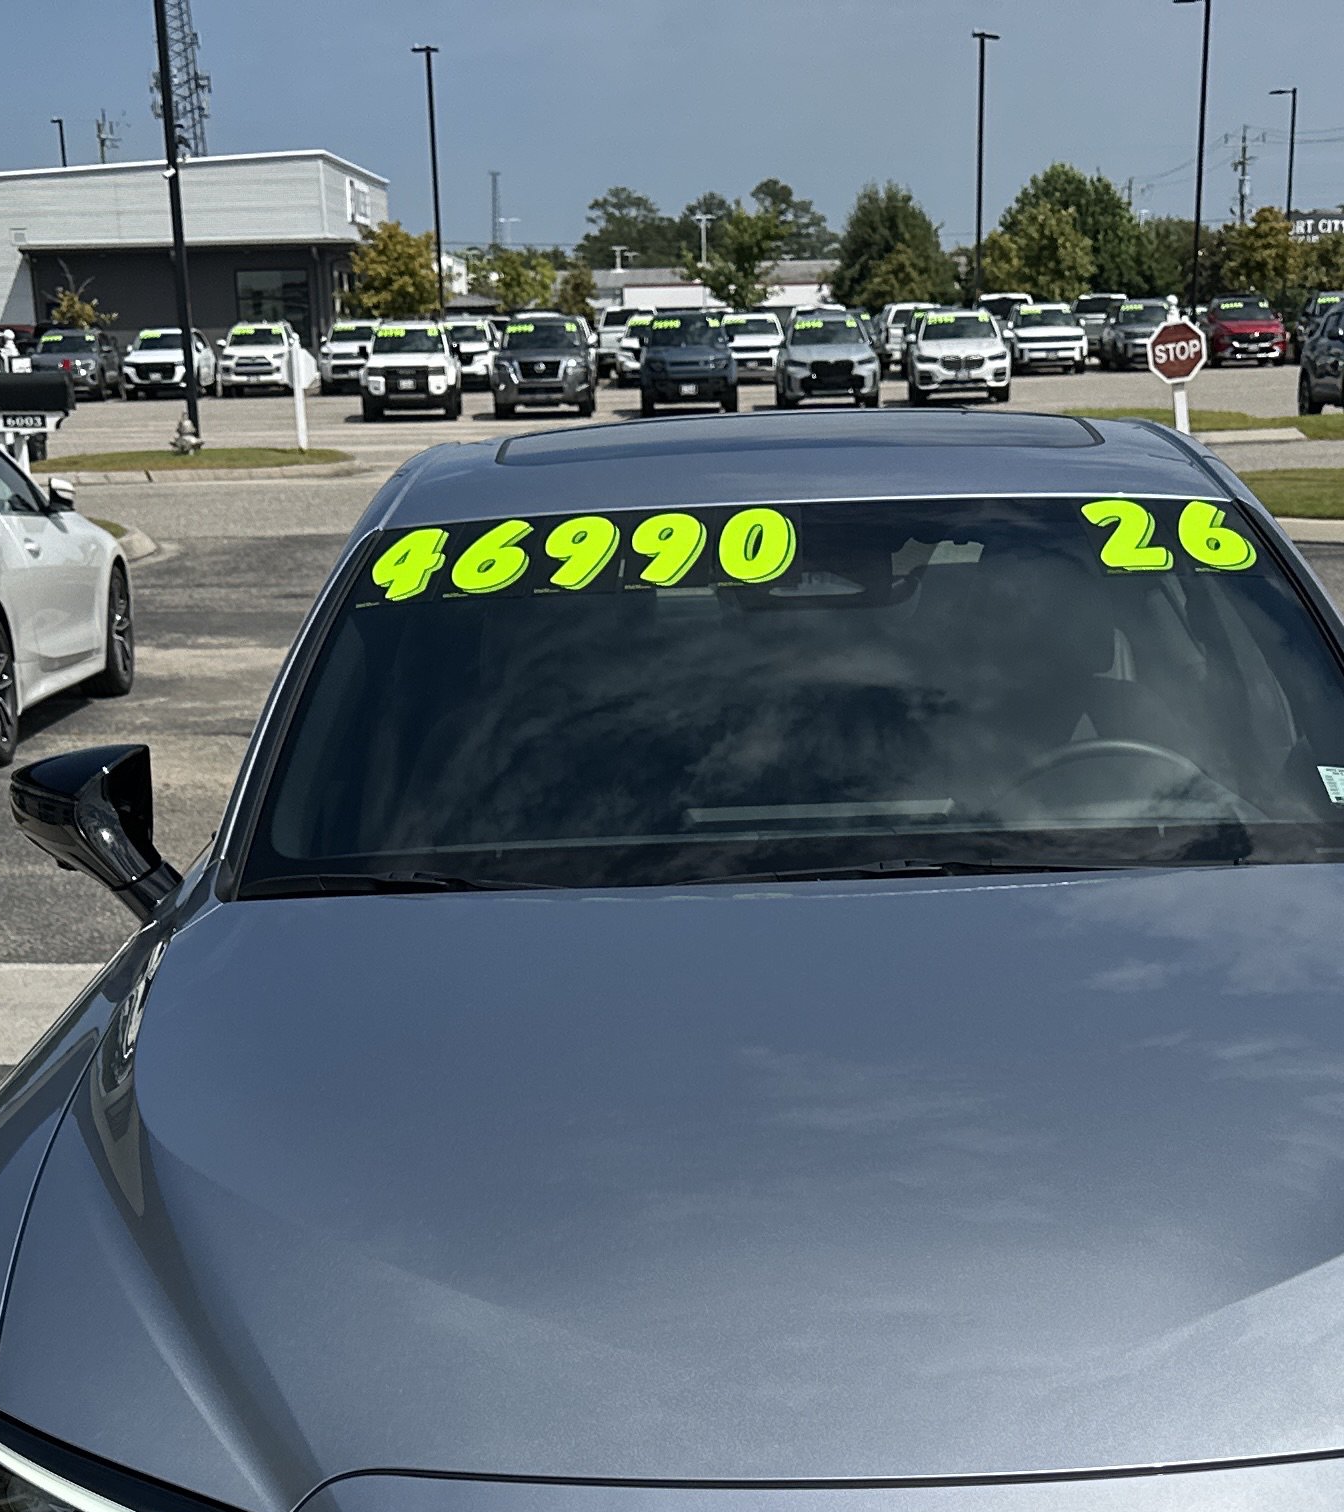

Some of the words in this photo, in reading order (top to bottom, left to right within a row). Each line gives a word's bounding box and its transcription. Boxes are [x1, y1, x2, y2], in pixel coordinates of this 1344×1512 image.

[1155, 339, 1202, 364] STOP
[372, 508, 797, 601] 46990
[1081, 500, 1257, 571] 26
